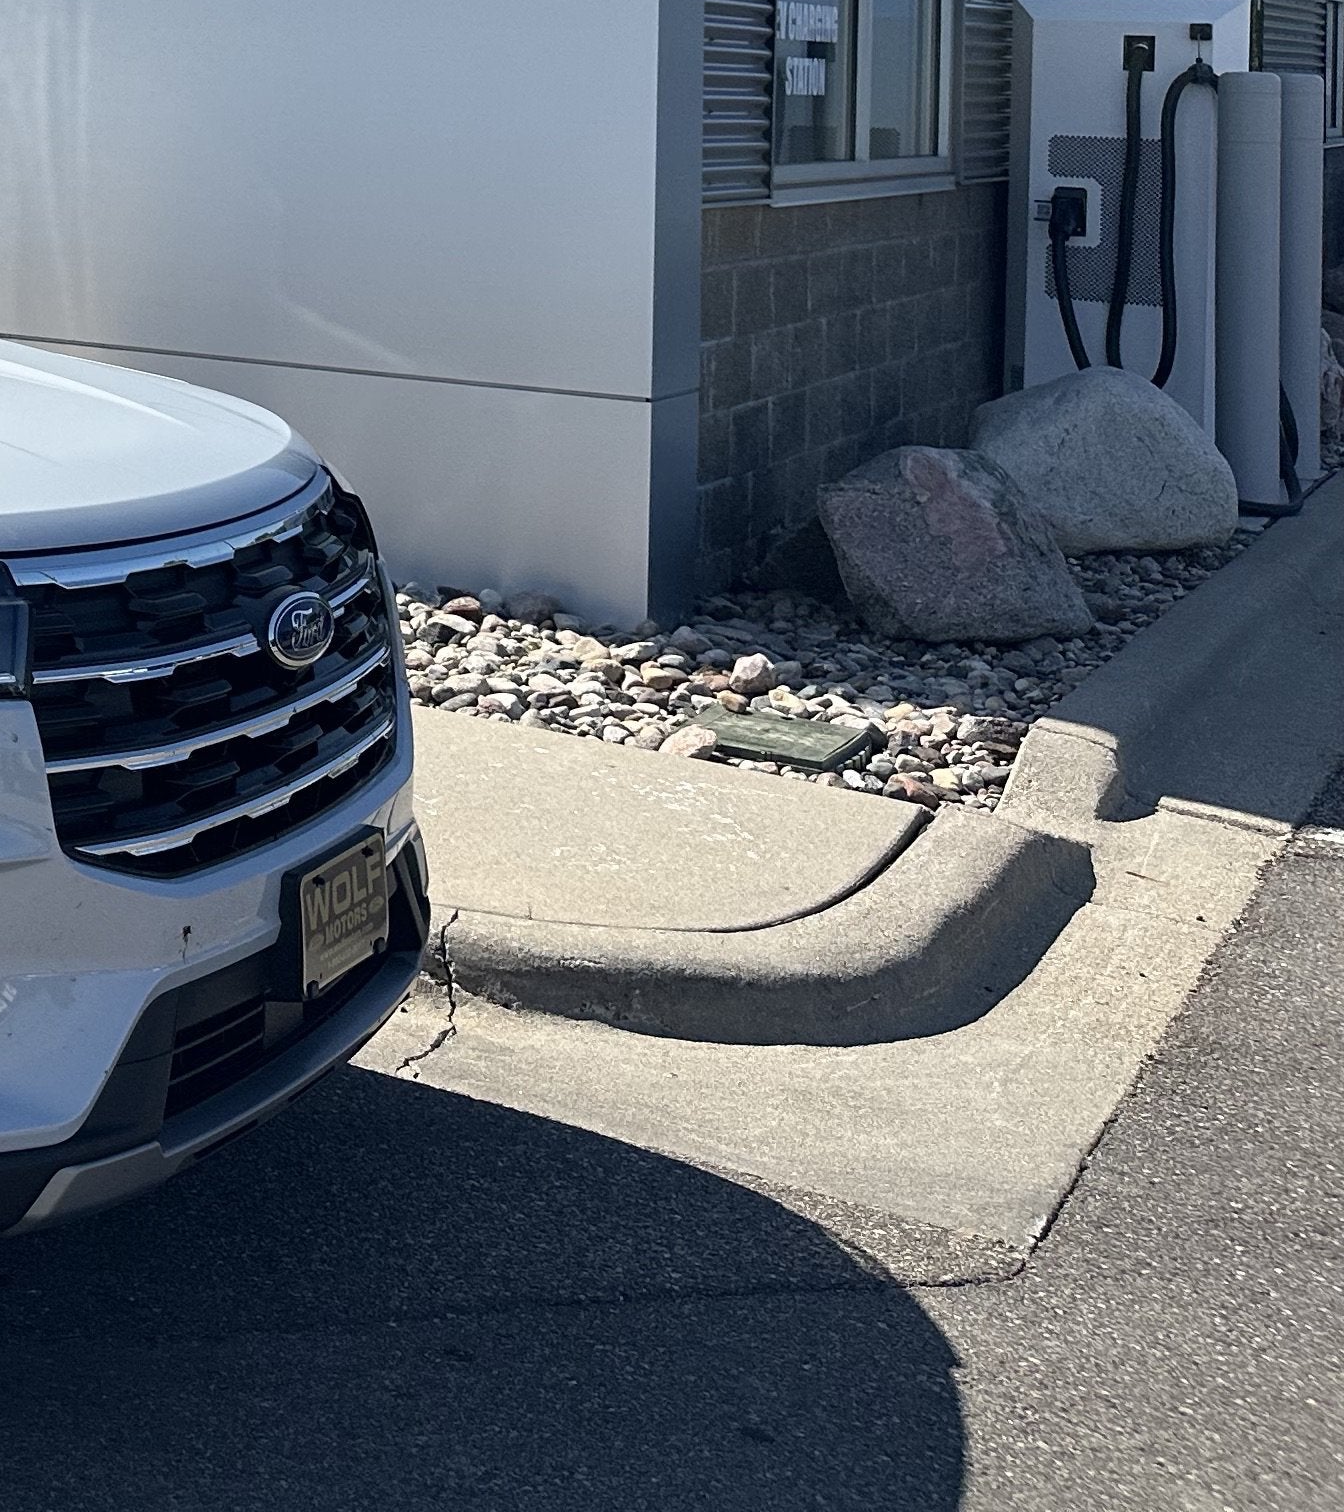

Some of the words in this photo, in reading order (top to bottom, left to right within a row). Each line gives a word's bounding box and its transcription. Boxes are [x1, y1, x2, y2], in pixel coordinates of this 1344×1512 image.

[788, 1, 838, 43] CHARGING
[785, 55, 826, 96] STATION
[291, 607, 325, 651] Ford
[306, 851, 382, 931] WOLF
[325, 901, 368, 945] MOTORS
